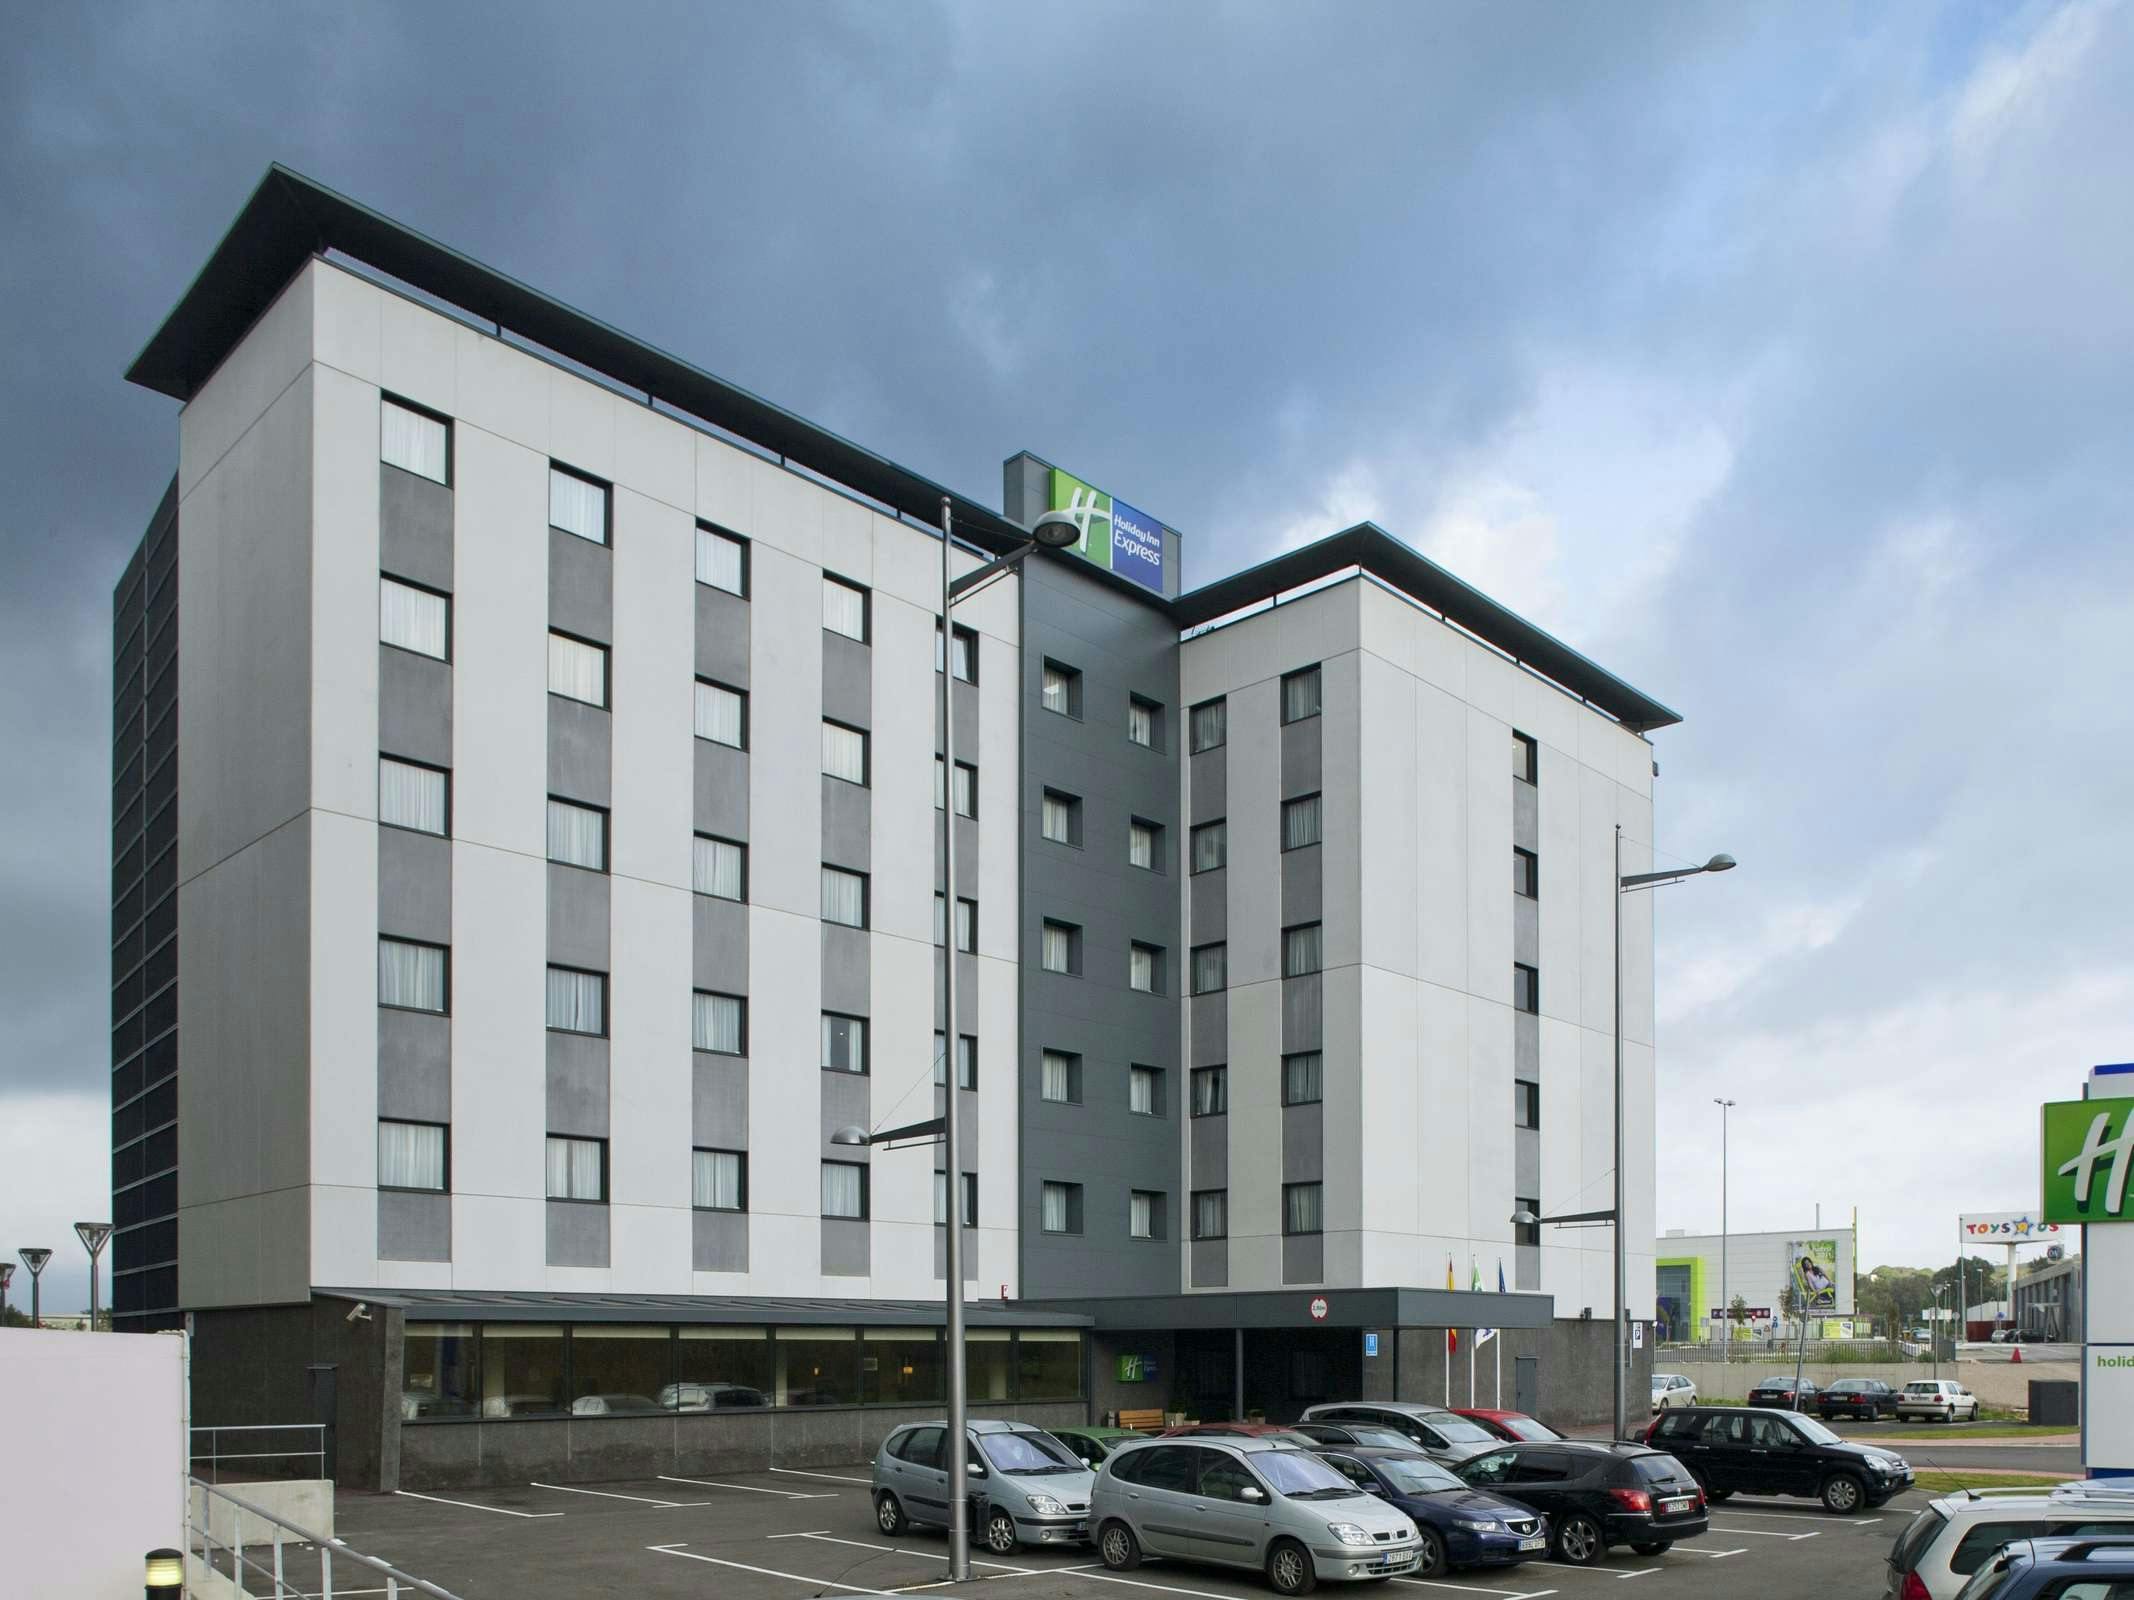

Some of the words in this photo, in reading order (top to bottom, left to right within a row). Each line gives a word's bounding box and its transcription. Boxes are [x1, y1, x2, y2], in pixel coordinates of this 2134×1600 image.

[1114, 514, 1146, 543] Holiday
[1146, 531, 1160, 547] Inn
[1114, 529, 1160, 566] Express
[1966, 1222, 2011, 1234] TOYS
